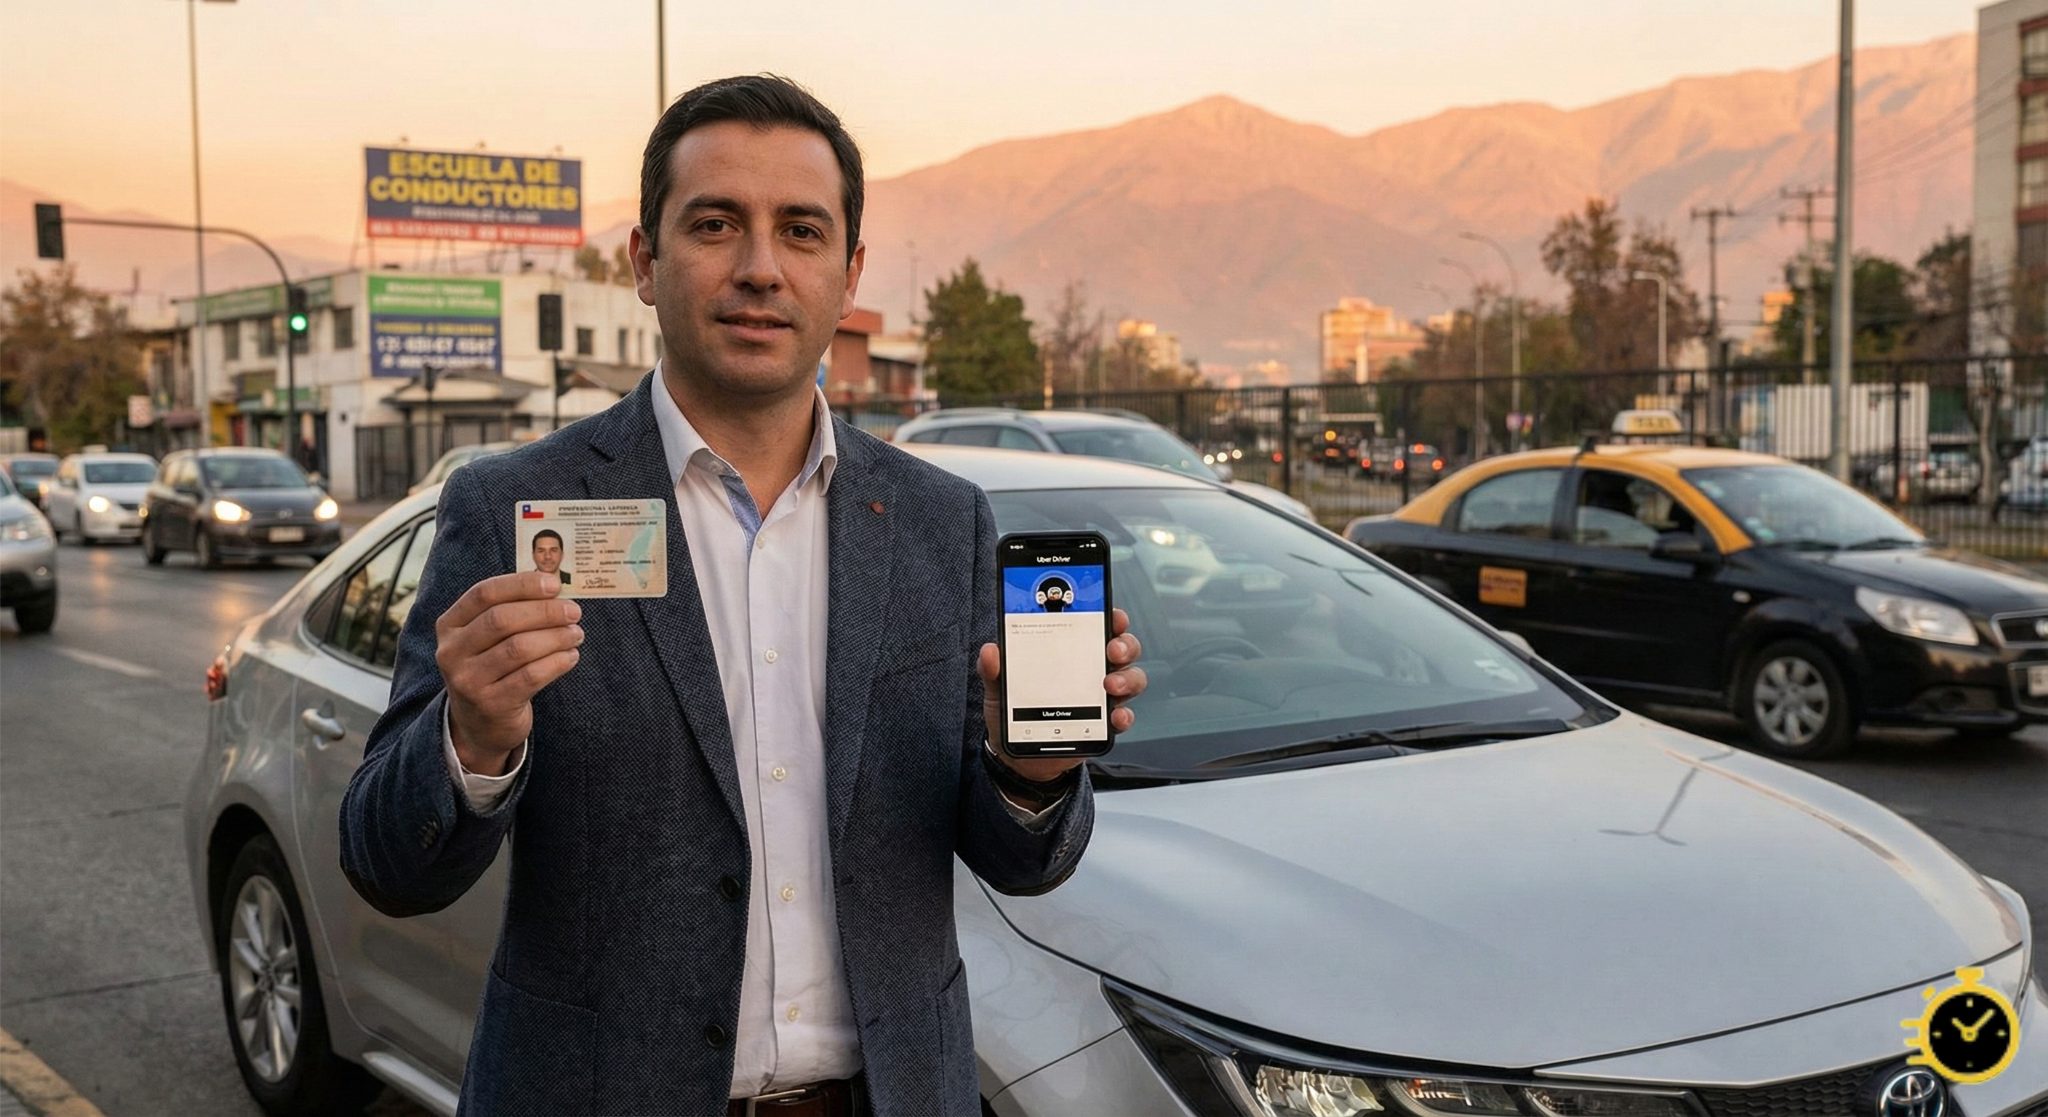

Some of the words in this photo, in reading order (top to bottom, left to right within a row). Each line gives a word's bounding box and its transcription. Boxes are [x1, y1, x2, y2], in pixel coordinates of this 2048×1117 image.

[388, 151, 517, 182] ESCUELA
[523, 161, 561, 184] DE
[369, 176, 579, 211] CONDUCTORES
